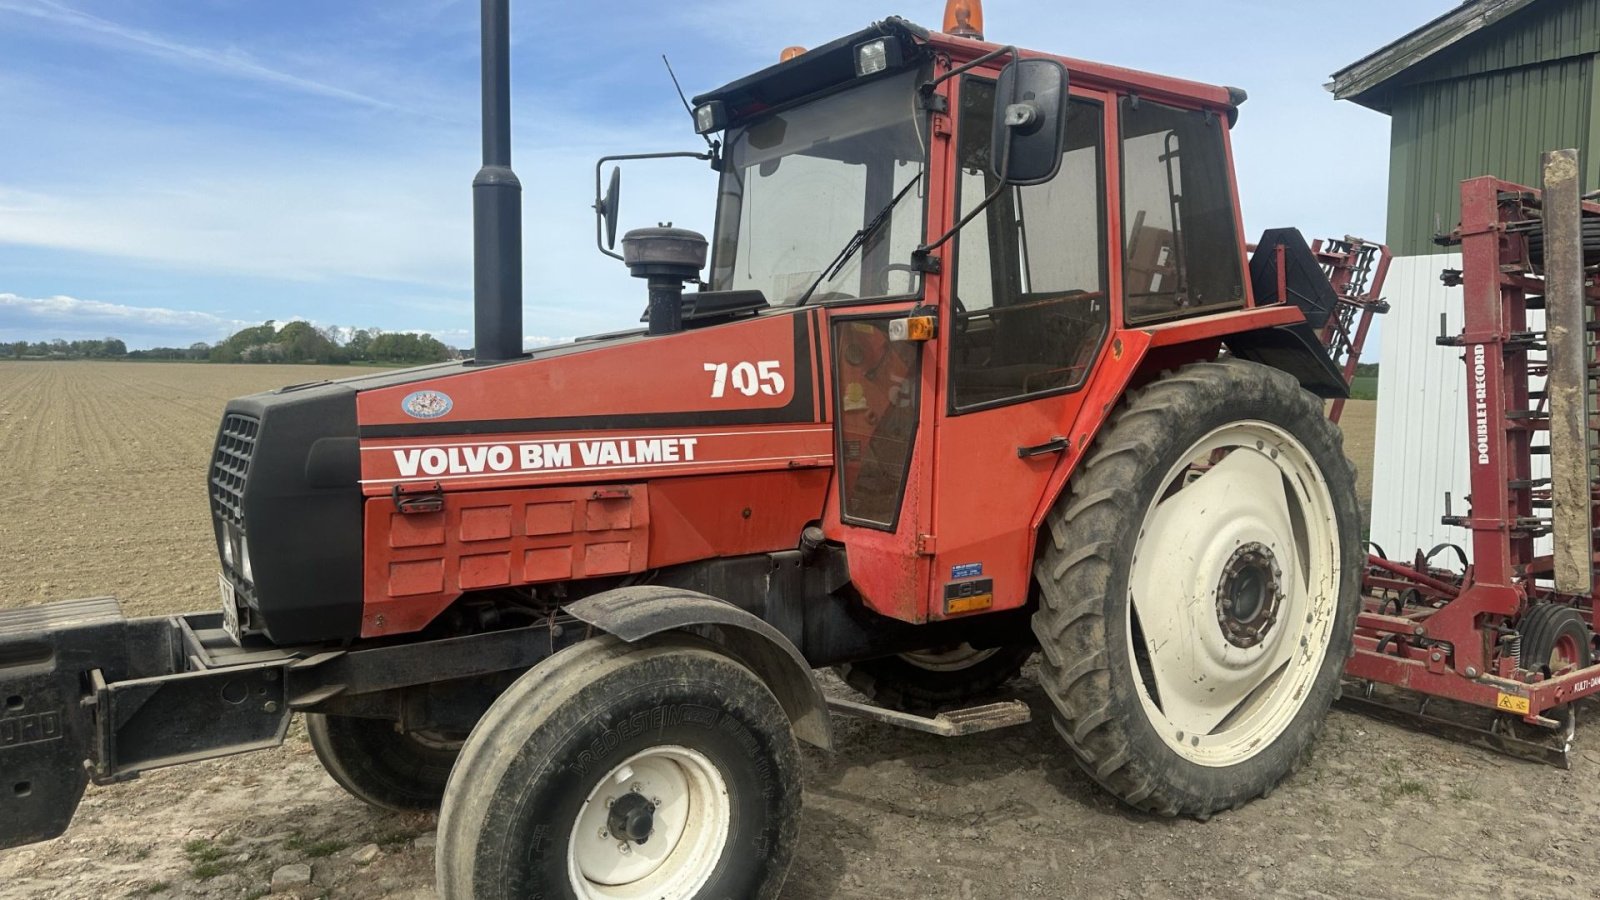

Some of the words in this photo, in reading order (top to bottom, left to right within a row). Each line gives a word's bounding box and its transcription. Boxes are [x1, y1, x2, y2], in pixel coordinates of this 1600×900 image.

[703, 360, 785, 398] 705
[393, 445, 513, 477] VOLVO
[519, 443, 572, 470] BM
[578, 438, 697, 466] VALMET
[569, 704, 684, 776] VREDESTEIN
